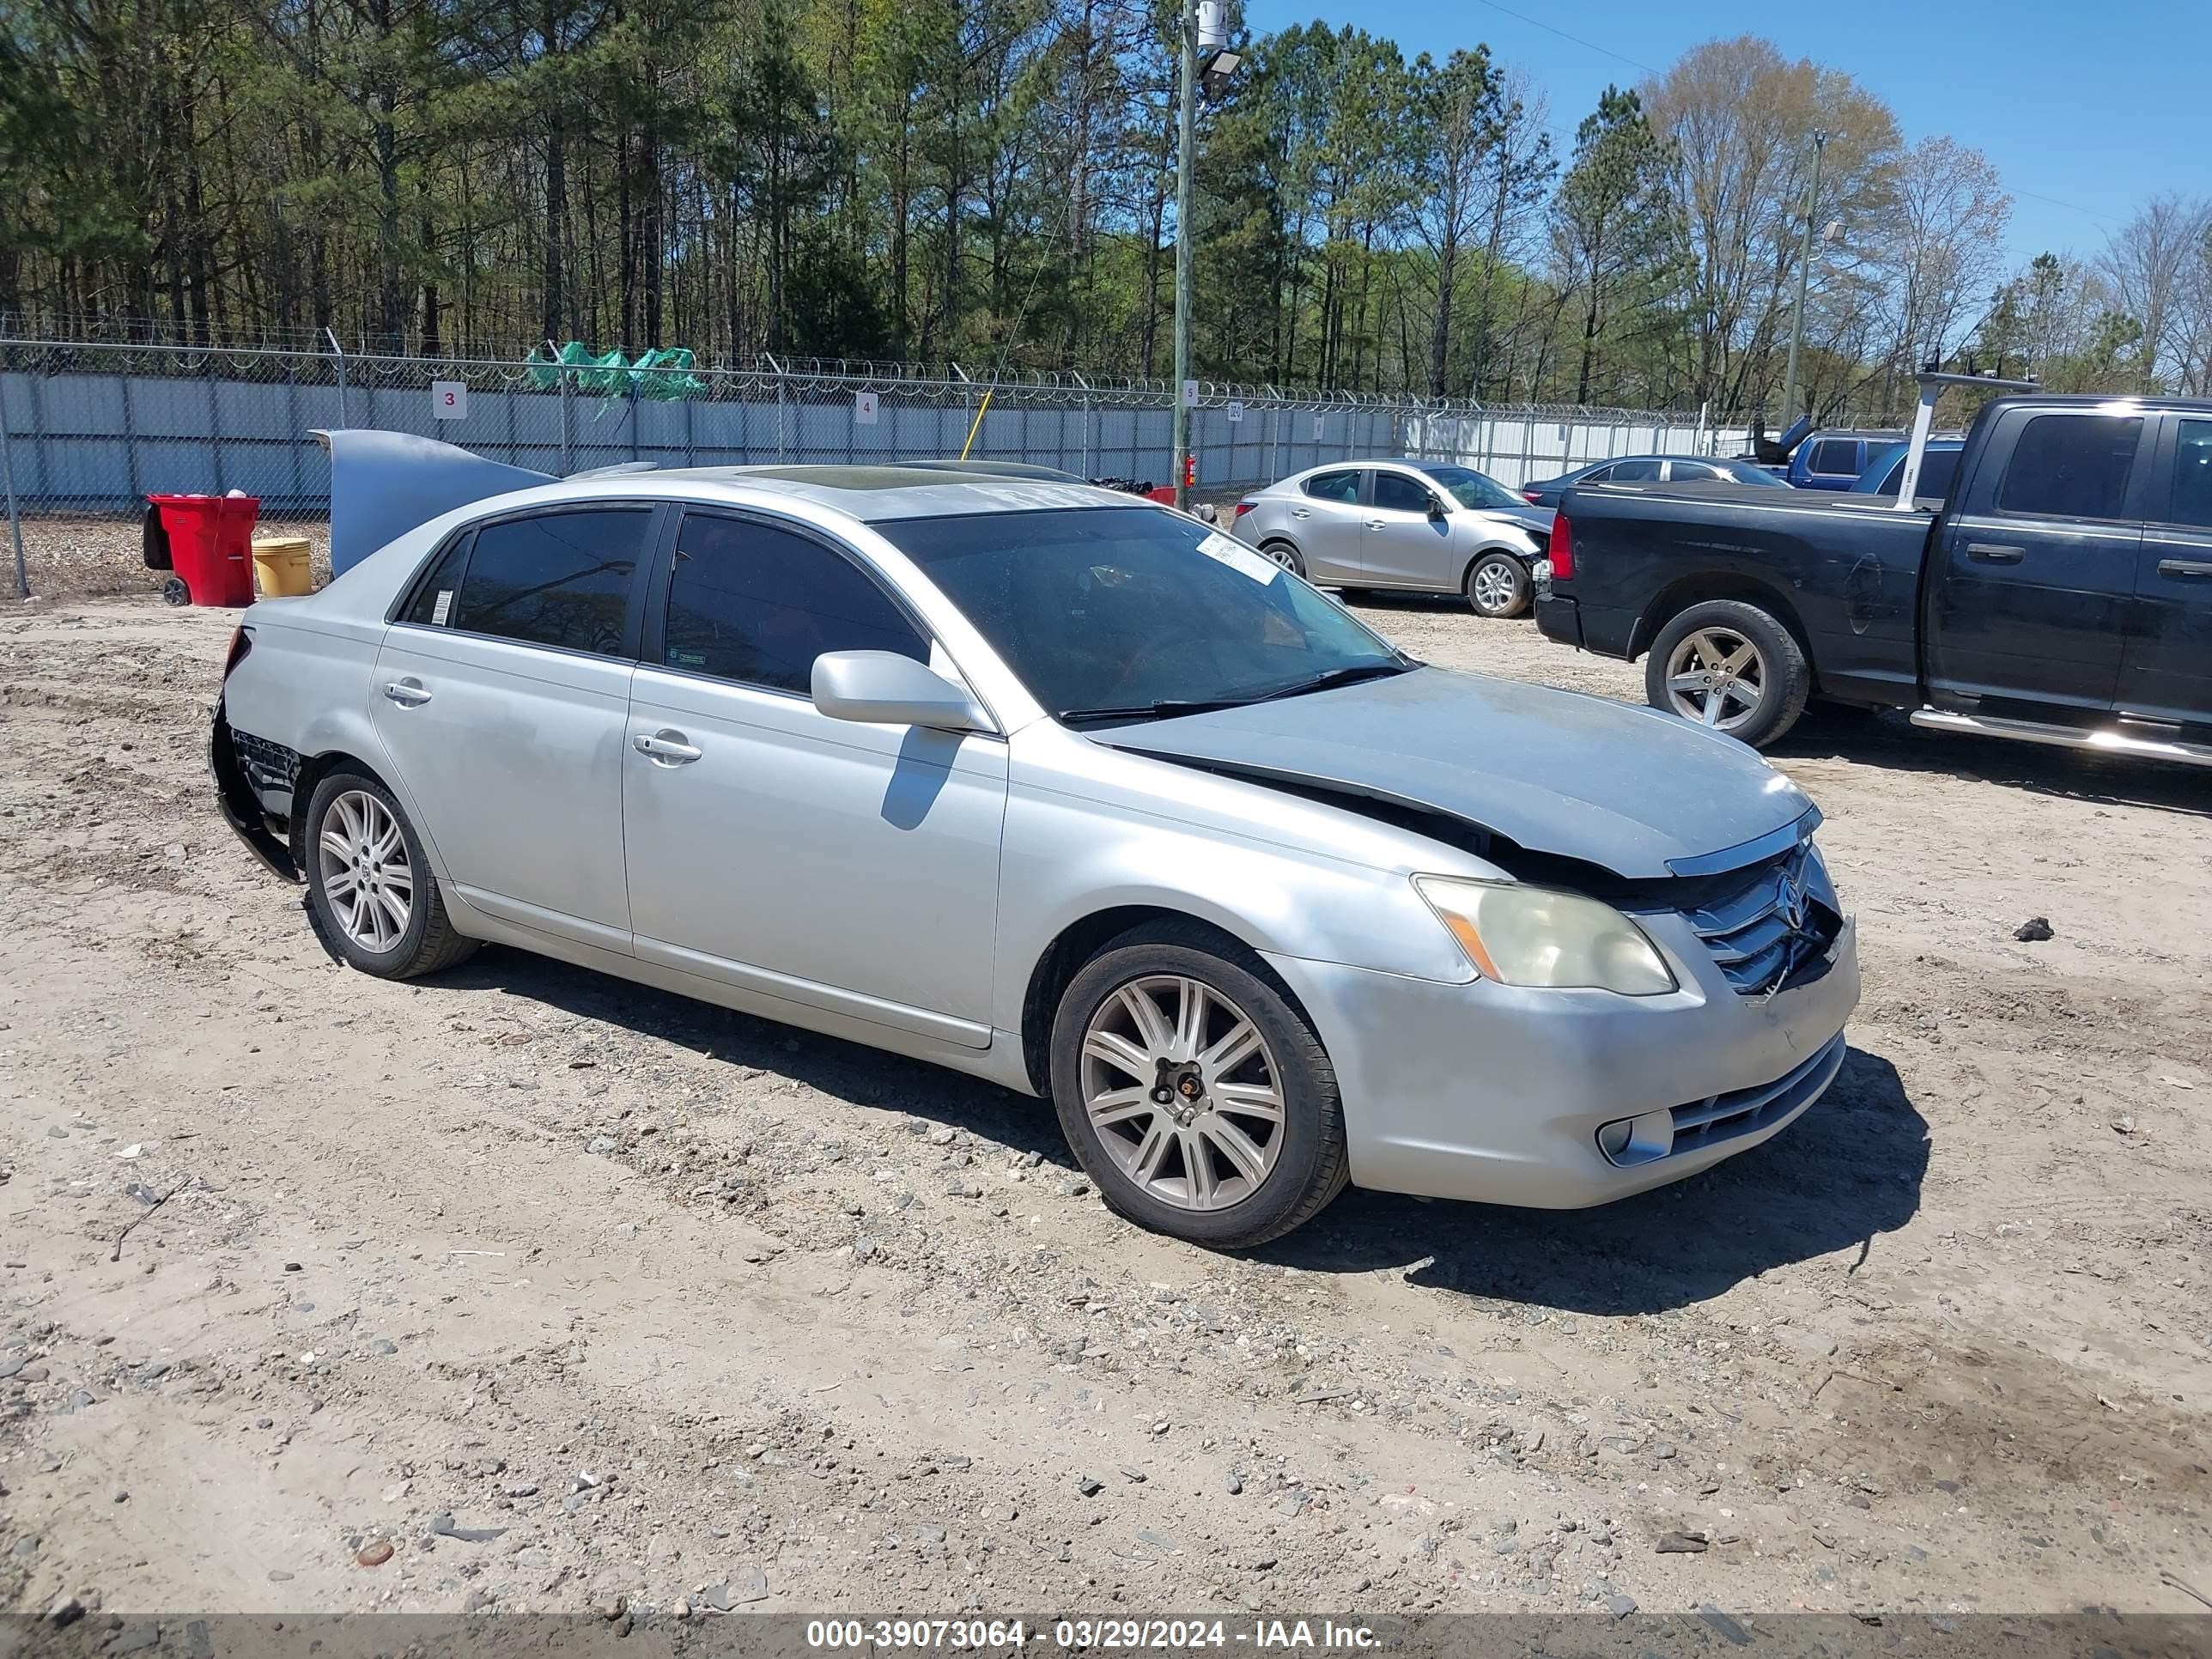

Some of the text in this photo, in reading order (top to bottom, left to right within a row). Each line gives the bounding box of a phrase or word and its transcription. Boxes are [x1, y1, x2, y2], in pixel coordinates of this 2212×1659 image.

[1188, 388, 1194, 398] 5
[445, 392, 455, 406] 3
[863, 402, 871, 413] 4
